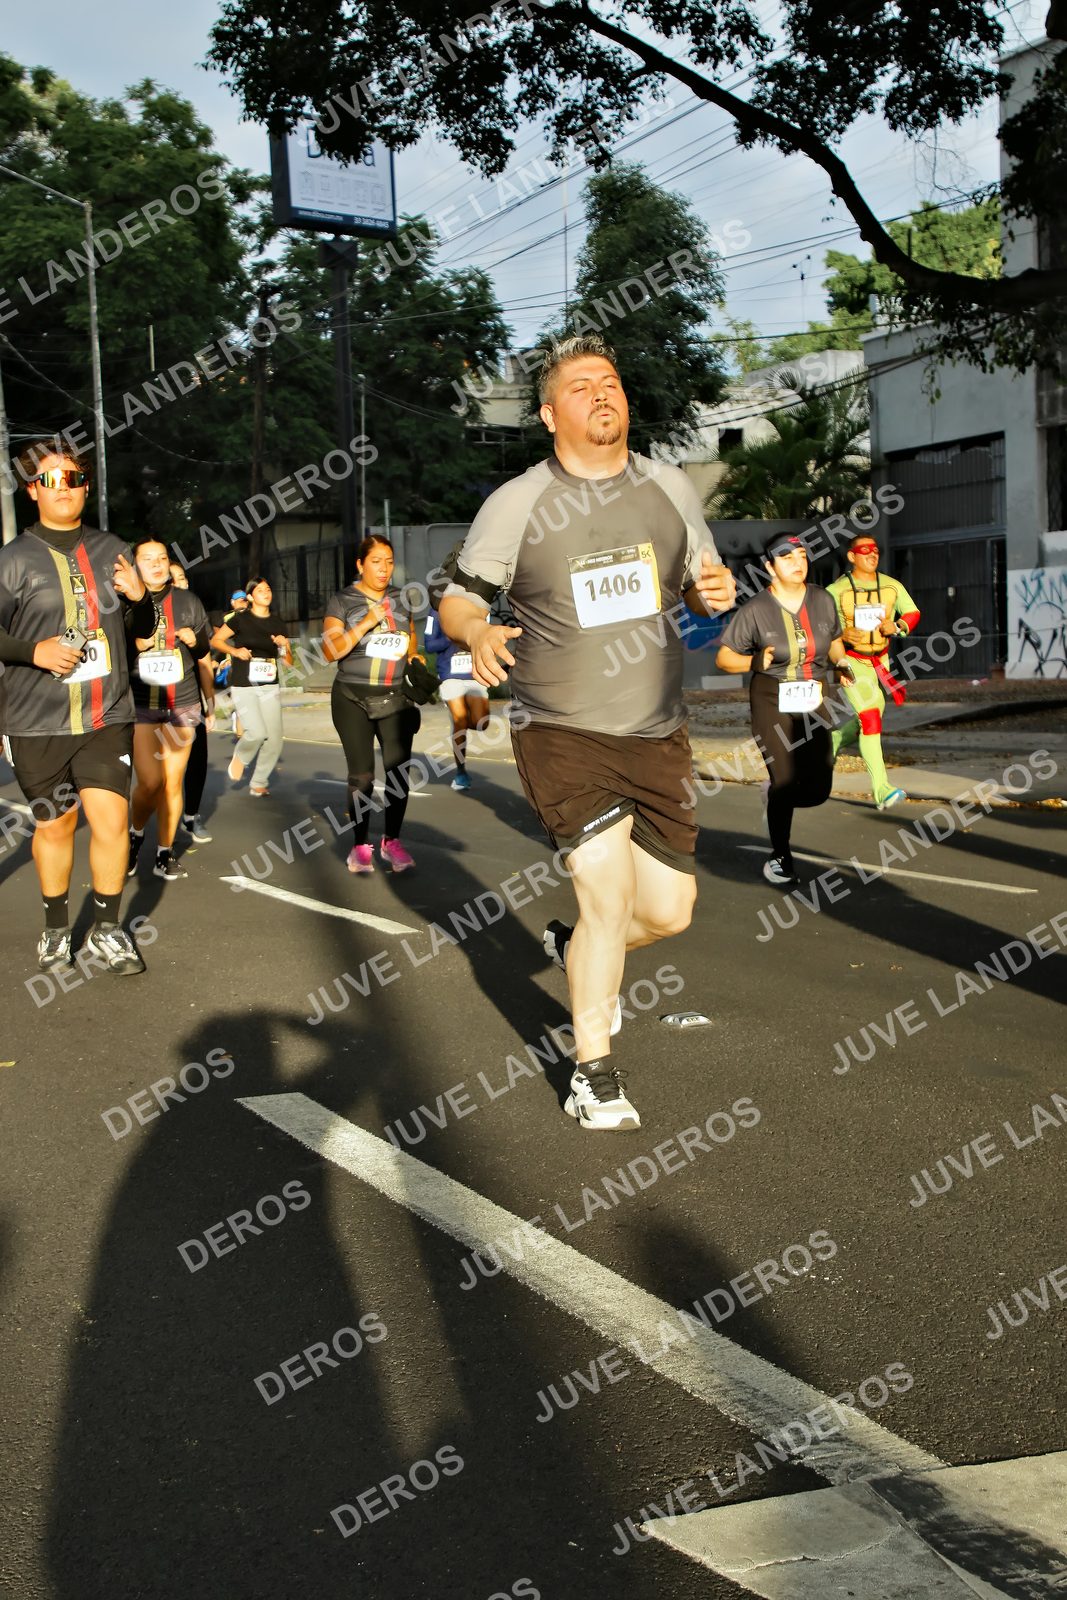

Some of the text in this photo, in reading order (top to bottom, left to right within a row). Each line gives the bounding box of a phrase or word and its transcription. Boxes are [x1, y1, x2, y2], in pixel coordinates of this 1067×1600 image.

[584, 571, 642, 602] 1406
[374, 637, 401, 649] 2039
[147, 661, 173, 673] 1272
